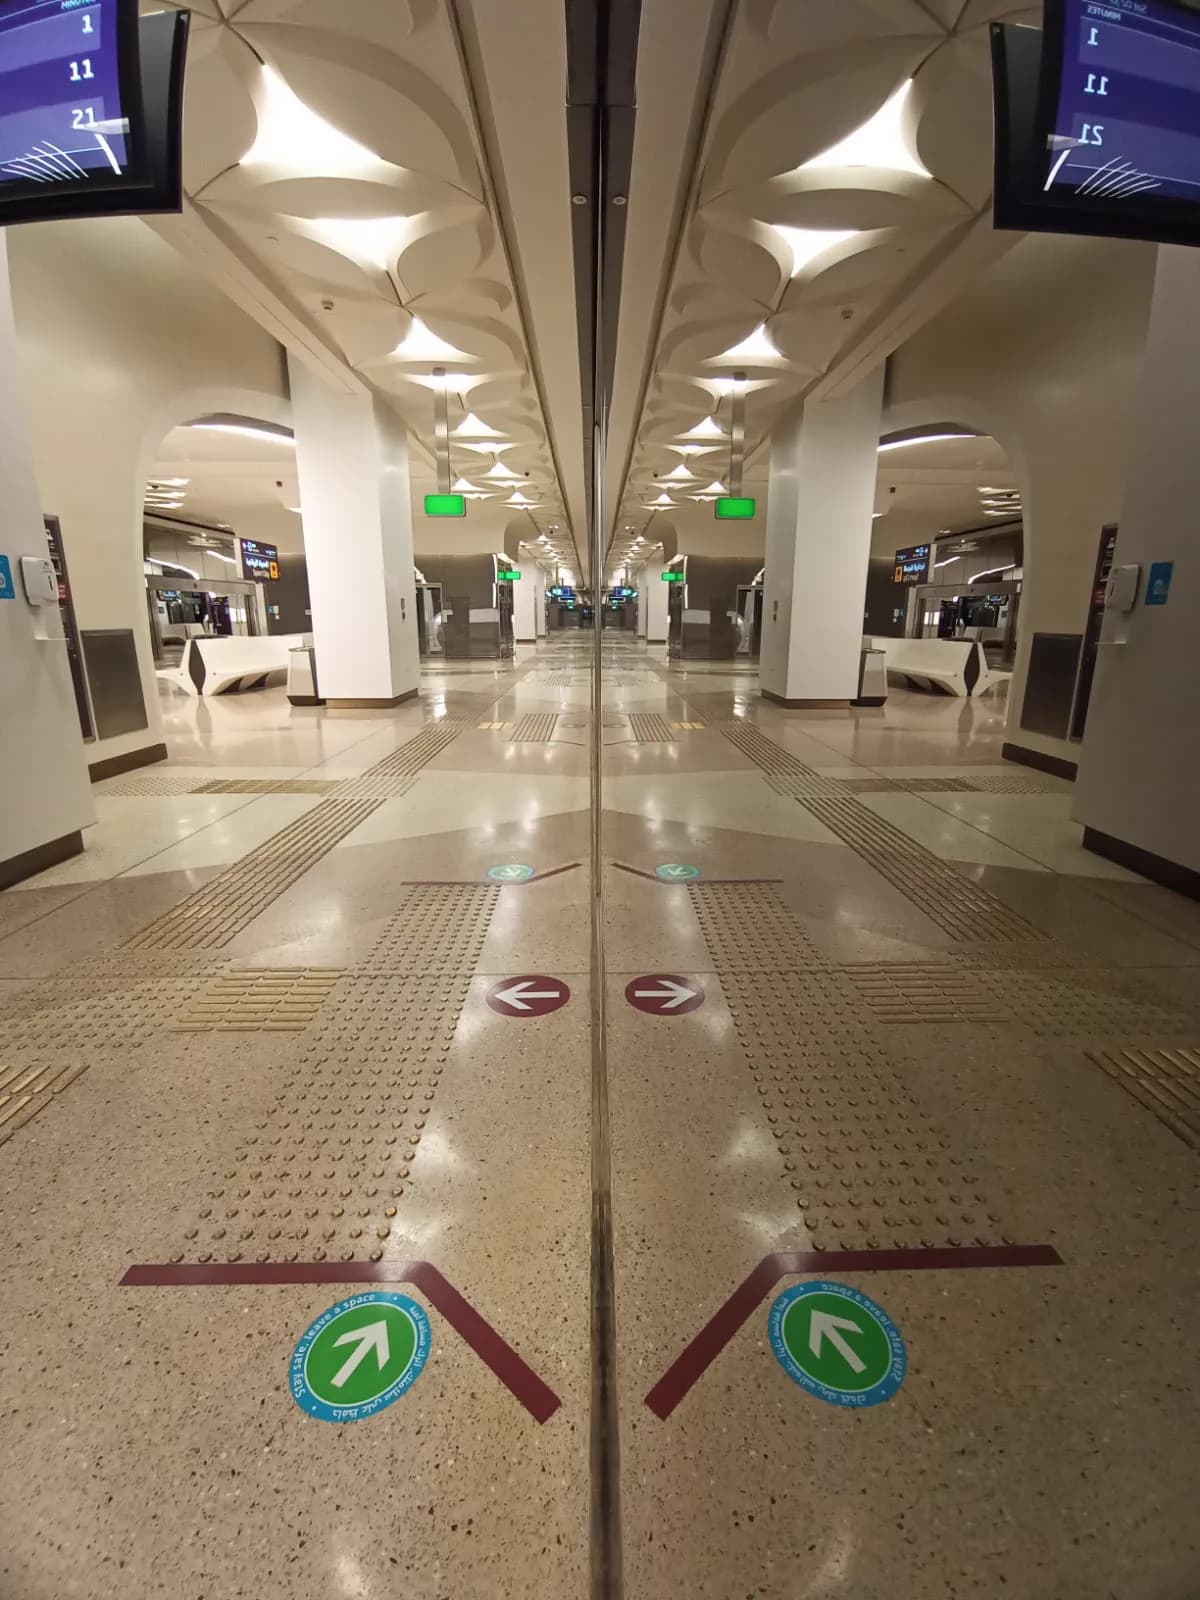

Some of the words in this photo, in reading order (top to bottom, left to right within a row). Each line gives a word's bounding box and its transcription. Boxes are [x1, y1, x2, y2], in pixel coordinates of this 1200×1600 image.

[82, 14, 94, 34] 1
[69, 59, 95, 81] 11
[71, 107, 97, 129] 21
[293, 1373, 306, 1399] Stay
[304, 1312, 332, 1341] leave
[334, 1306, 342, 1315] a
[343, 1293, 376, 1310] space
[332, 1407, 359, 1419] حافظ
